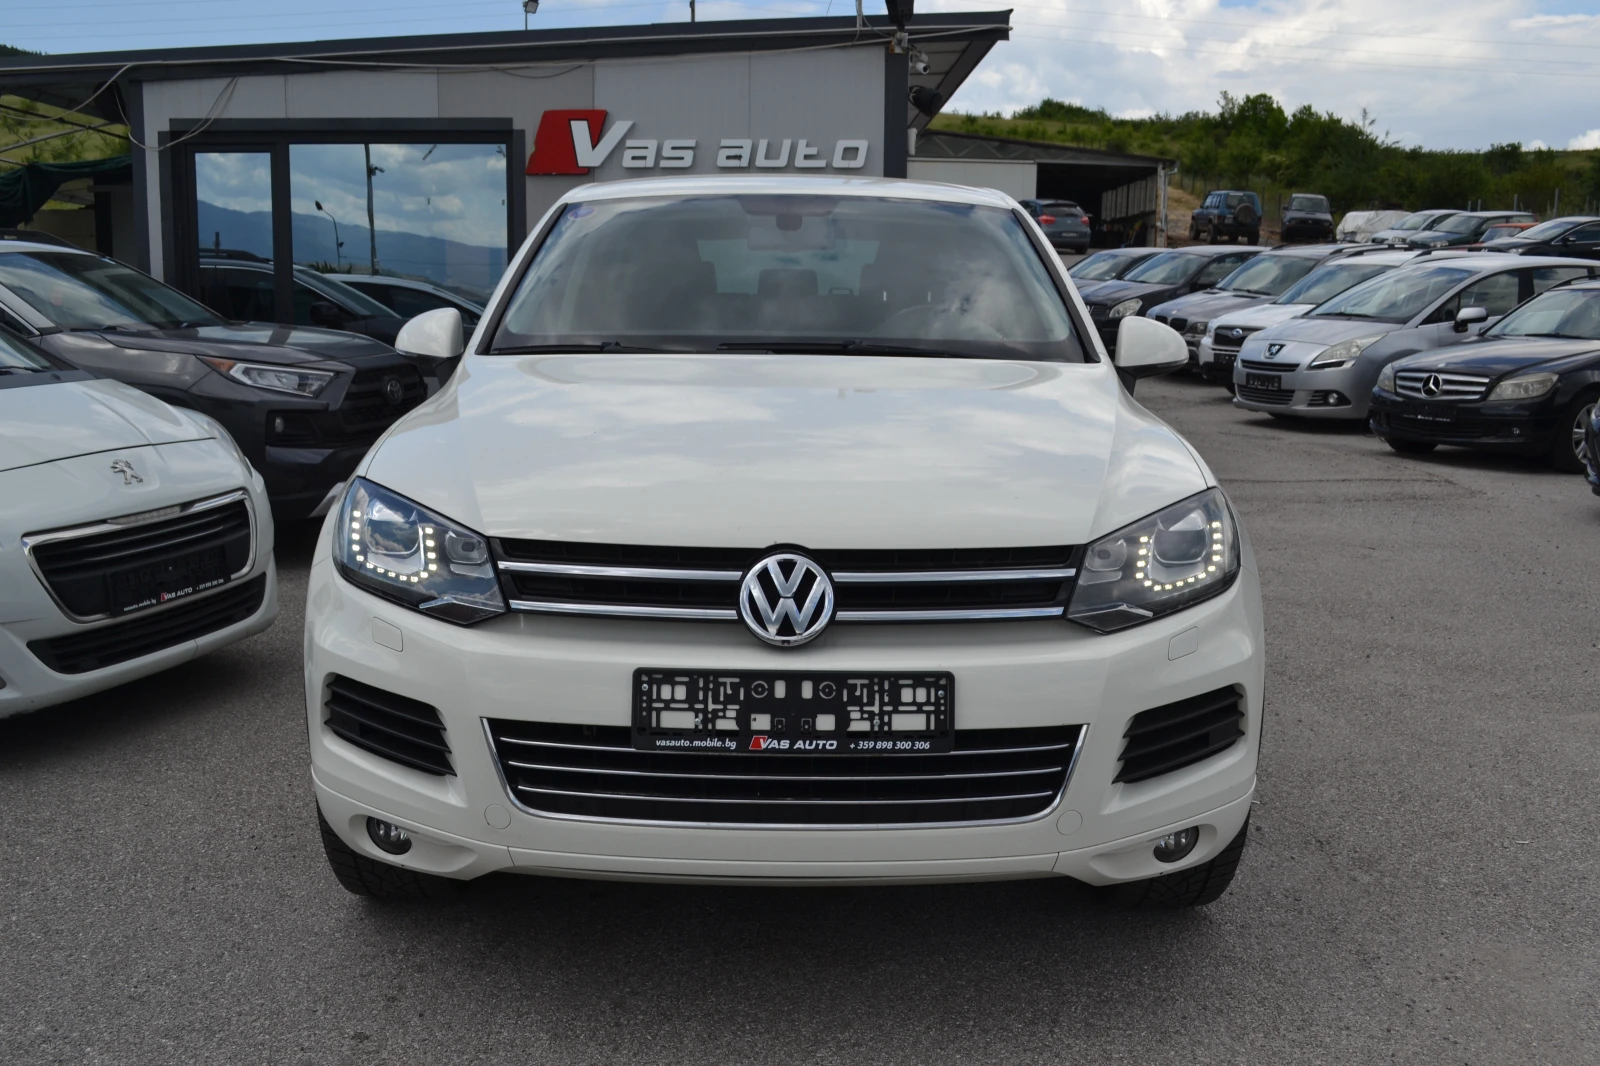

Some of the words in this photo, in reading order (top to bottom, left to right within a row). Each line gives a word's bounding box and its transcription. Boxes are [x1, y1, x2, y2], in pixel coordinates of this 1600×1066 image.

[177, 587, 193, 597] AUTO
[655, 737, 737, 750] vasauto.mobile.bg
[759, 738, 790, 749] VAS
[793, 740, 838, 750] AUTO
[857, 741, 875, 749] 359
[875, 741, 893, 749] 898
[894, 741, 912, 750] 300
[913, 741, 930, 750] 306
